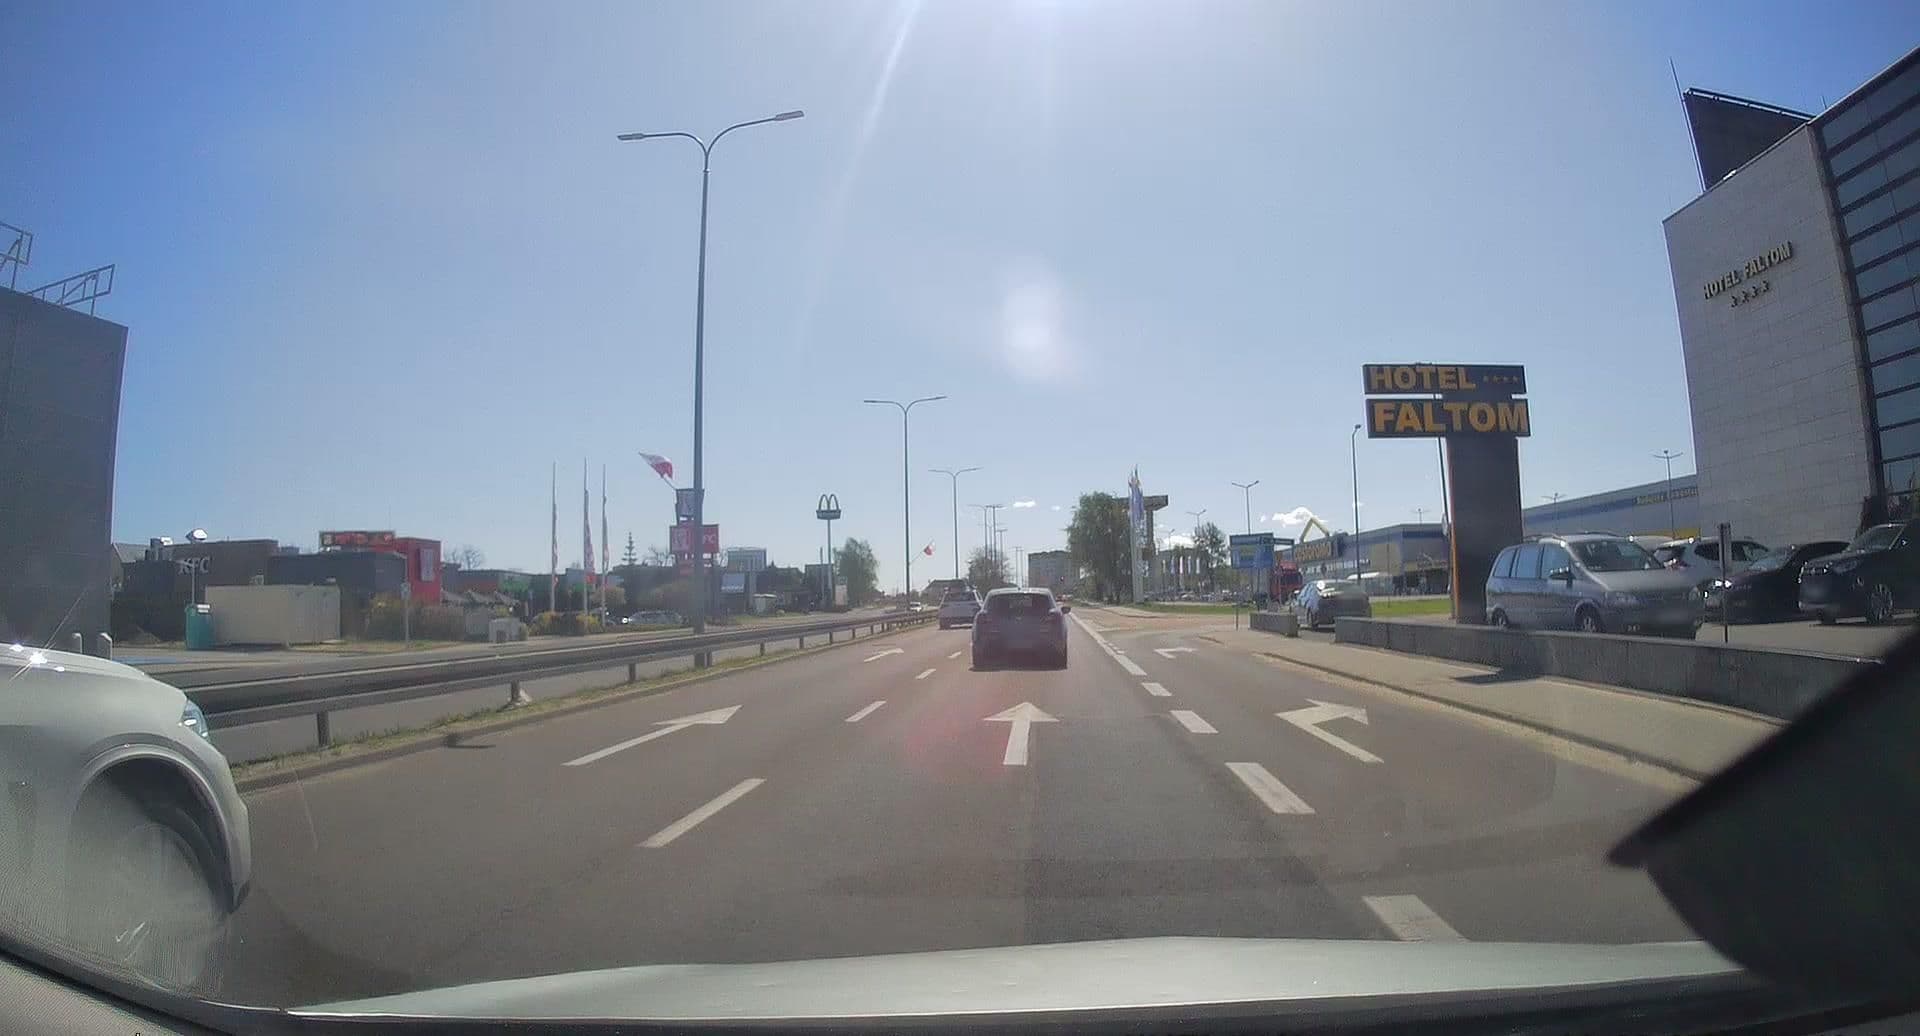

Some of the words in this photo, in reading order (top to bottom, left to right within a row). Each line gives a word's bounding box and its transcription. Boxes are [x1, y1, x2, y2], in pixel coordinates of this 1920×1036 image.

[1703, 270, 1742, 300] HOTEL
[1744, 240, 1793, 279] FALTOM
[1369, 365, 1477, 391] HOTEL
[1373, 401, 1530, 433] FALTOM
